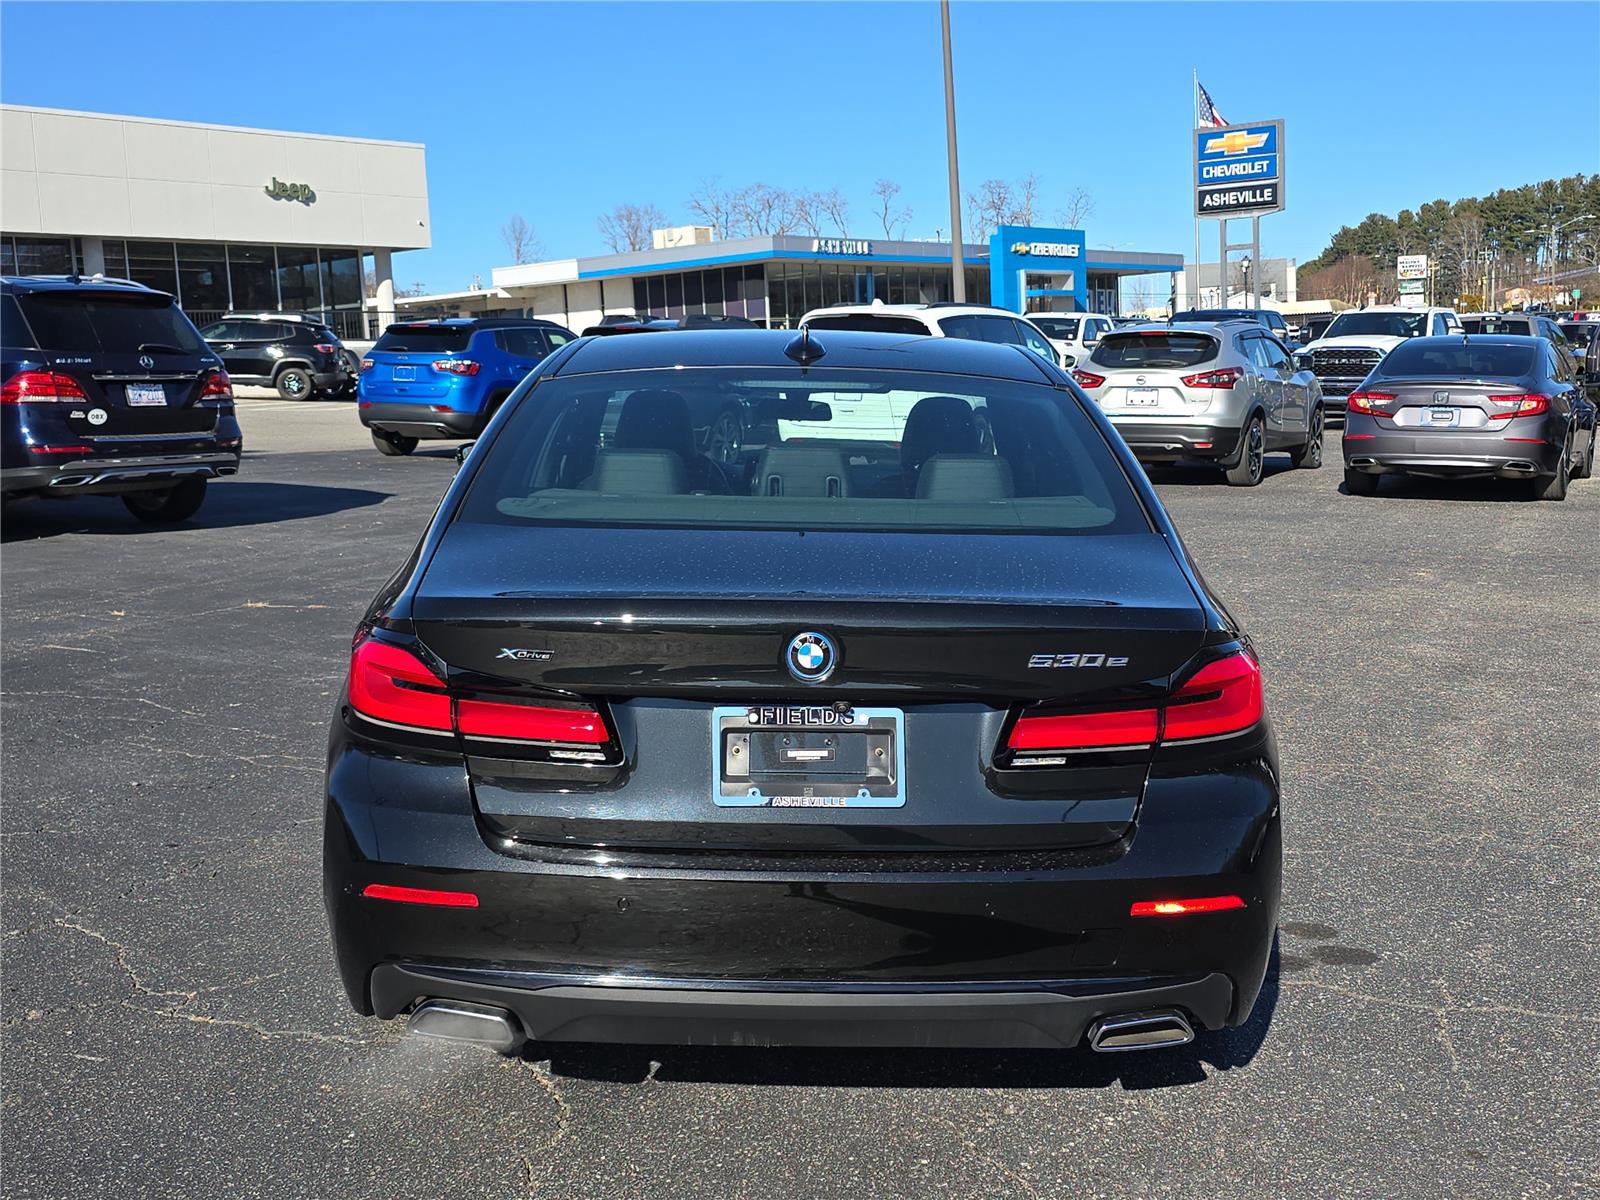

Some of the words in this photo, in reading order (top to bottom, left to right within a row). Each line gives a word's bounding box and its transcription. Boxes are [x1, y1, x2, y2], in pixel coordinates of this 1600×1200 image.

[1203, 160, 1269, 178] CHEVROLET
[264, 177, 310, 202] Jeep
[1203, 188, 1273, 207] ASHEVILLE
[1030, 242, 1080, 258] CHEVROLET
[793, 635, 828, 650] BMW
[1028, 653, 1129, 668] 530e
[772, 796, 847, 807] ASHEVILLE
